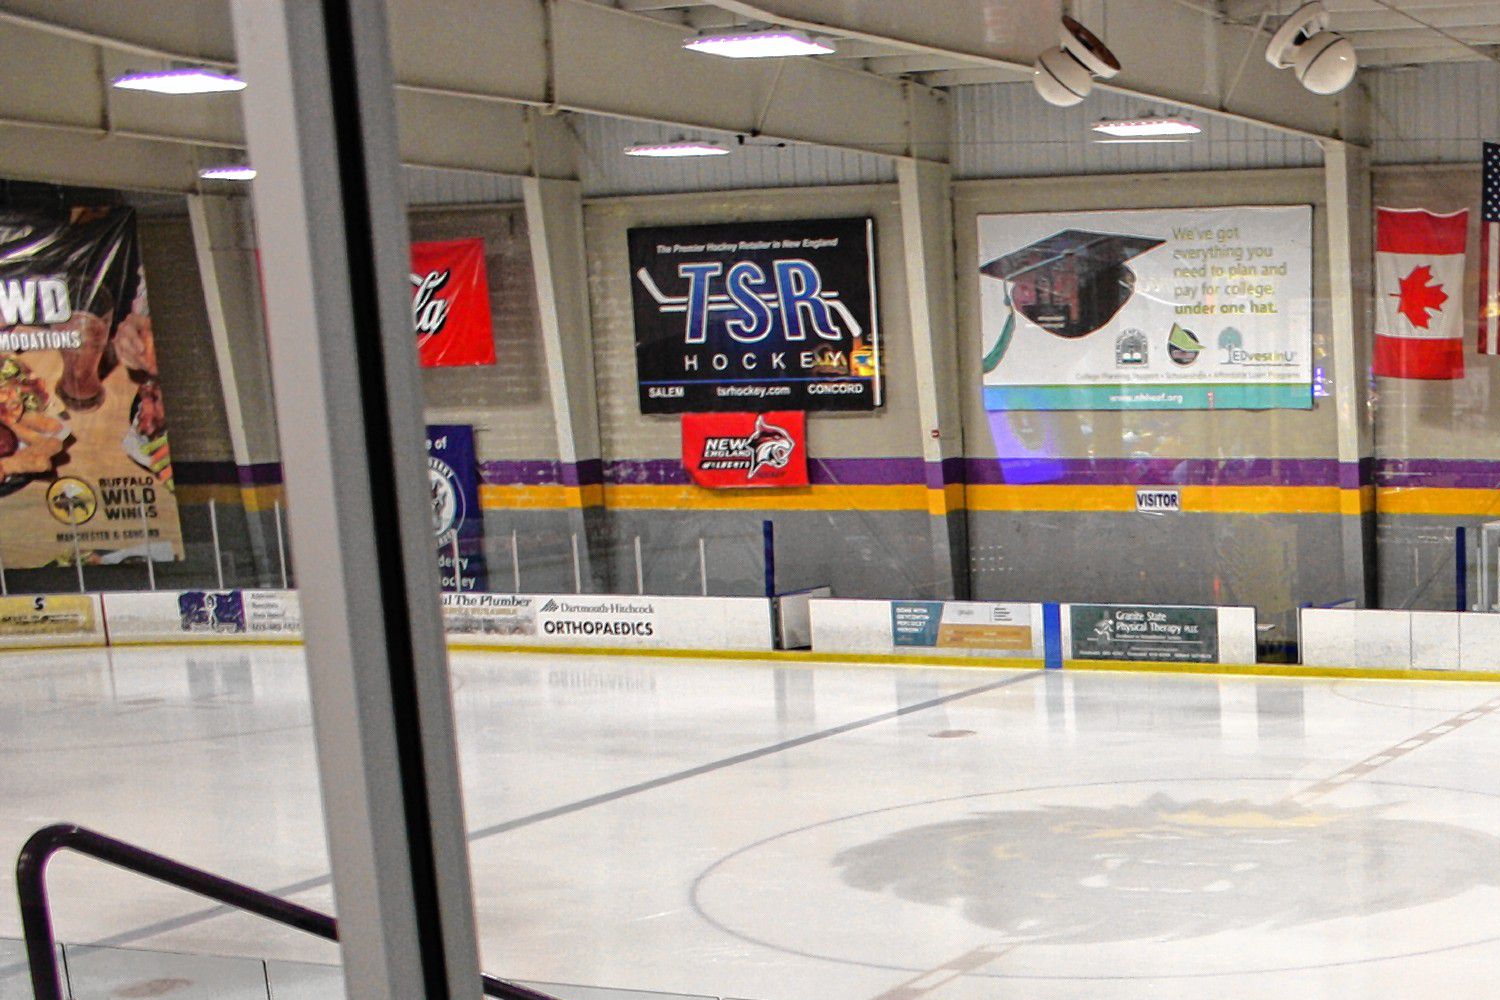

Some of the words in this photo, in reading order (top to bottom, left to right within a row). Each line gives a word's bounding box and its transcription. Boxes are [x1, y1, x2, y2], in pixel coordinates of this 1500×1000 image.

[1217, 227, 1239, 242] got
[802, 237, 839, 250] England
[1173, 246, 1243, 262] everything
[1247, 247, 1273, 261] you
[1173, 264, 1206, 278] need
[1211, 265, 1224, 277] to
[1229, 263, 1256, 279] plan
[1261, 262, 1288, 276] and
[1174, 286, 1198, 299] pay
[1201, 282, 1220, 296] for
[0, 279, 72, 325] WD
[677, 258, 842, 344] TSR
[1175, 301, 1216, 314] under
[1220, 303, 1245, 313] one
[0, 331, 82, 350] MODATIONS
[684, 351, 844, 372] HOCKEY
[649, 386, 685, 398] SALEM
[716, 385, 791, 399] tsrhockey.com
[807, 383, 864, 395] CONCORD
[706, 438, 747, 451] NEW
[704, 449, 751, 458] ENGLAND
[99, 476, 154, 488] BUFFALO
[101, 488, 156, 506] WILD
[1136, 493, 1179, 507] VISITOR
[454, 594, 477, 606] The
[480, 594, 533, 608] Plumber
[1115, 610, 1145, 622] Granite
[1146, 611, 1167, 622] State
[544, 620, 653, 637] ORTHOPAEDICS
[1116, 621, 1147, 634] Physical
[1148, 622, 1182, 635] Therapy
